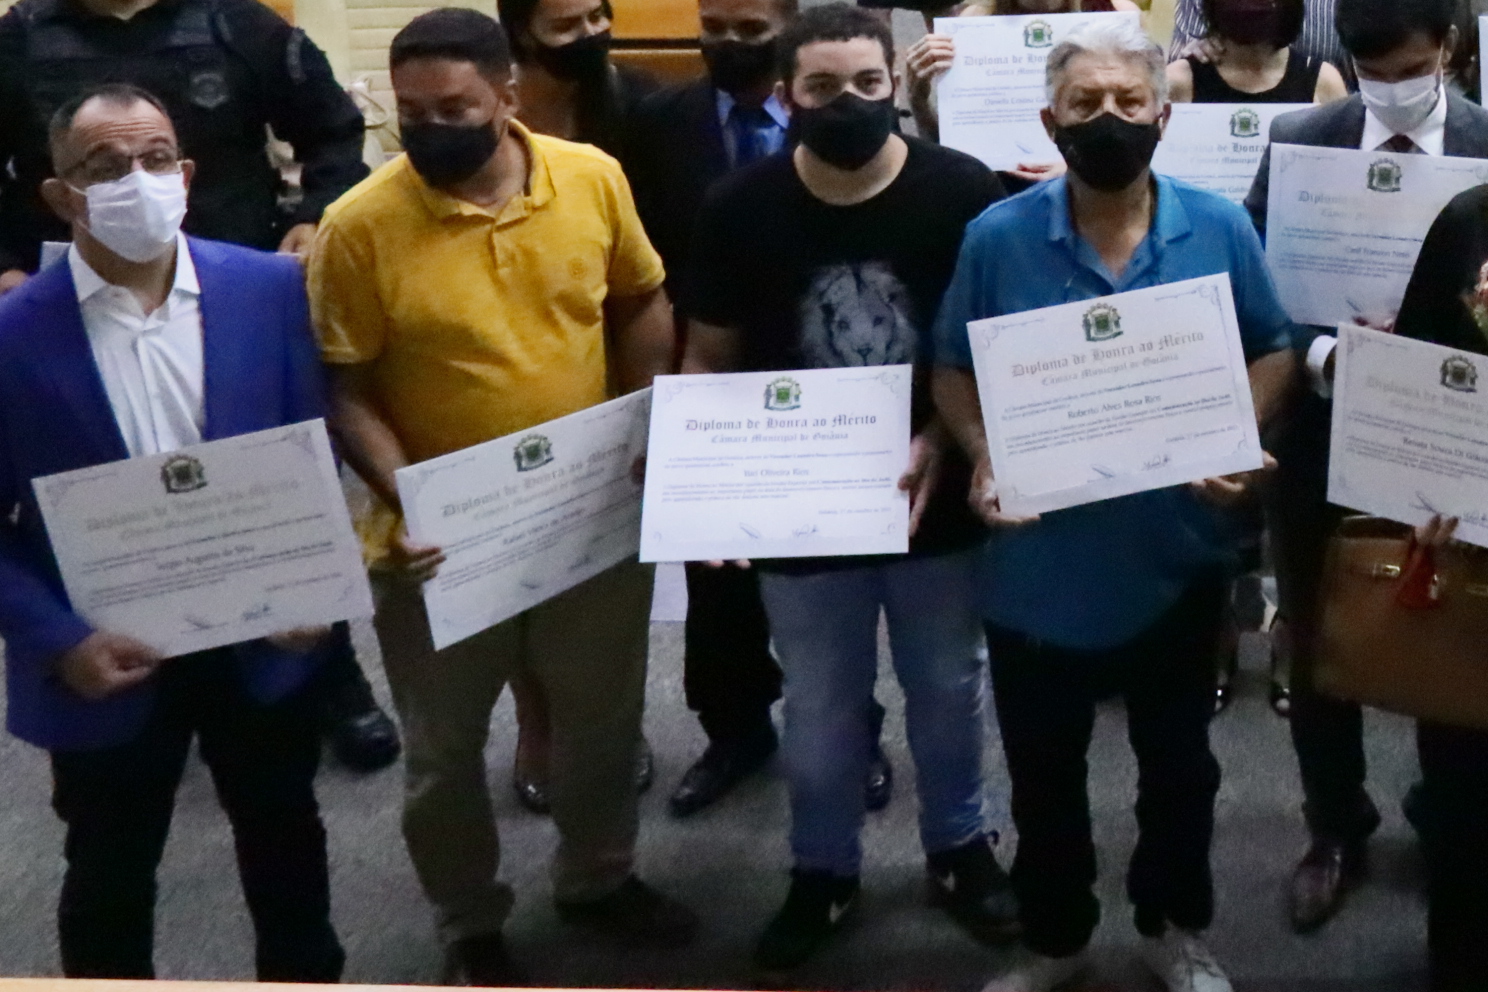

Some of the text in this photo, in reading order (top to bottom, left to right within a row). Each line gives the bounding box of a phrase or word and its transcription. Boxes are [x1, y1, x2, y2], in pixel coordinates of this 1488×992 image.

[1011, 358, 1068, 378] Diploma
[1073, 354, 1086, 365] de
[1092, 345, 1135, 362] Honra
[1139, 343, 1153, 353] ao
[685, 413, 877, 432] Diploma de Honra ao Mérito
[750, 432, 798, 444] Municipal
